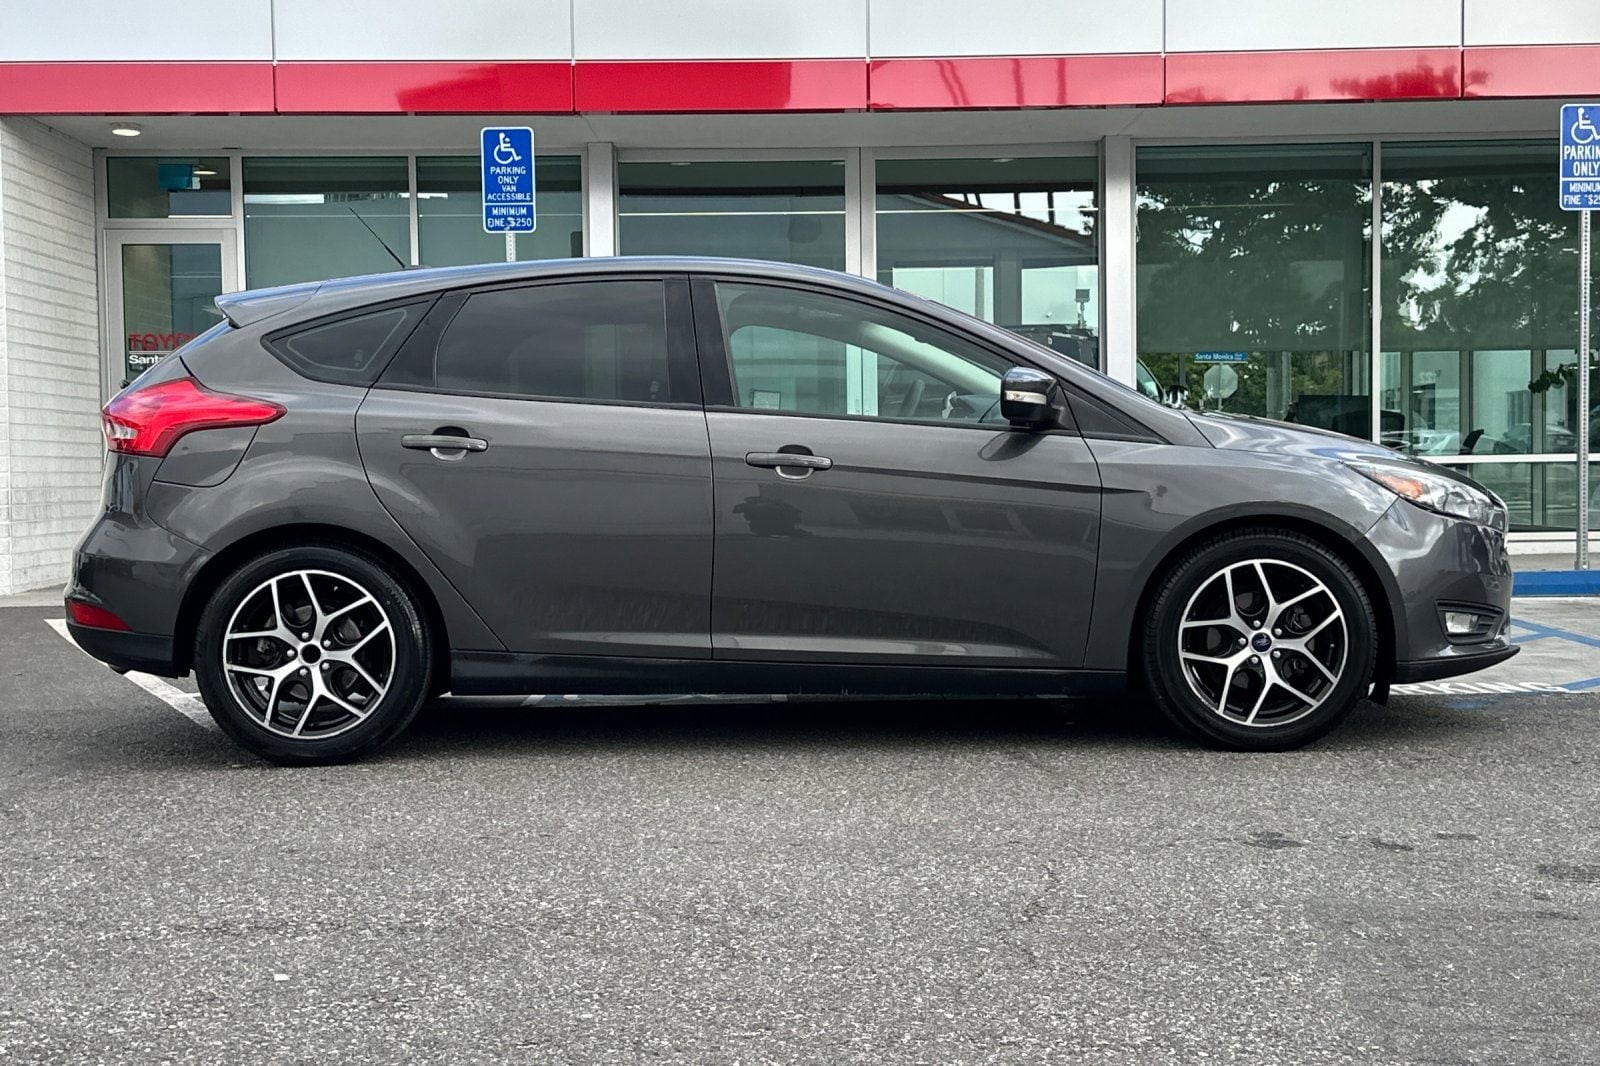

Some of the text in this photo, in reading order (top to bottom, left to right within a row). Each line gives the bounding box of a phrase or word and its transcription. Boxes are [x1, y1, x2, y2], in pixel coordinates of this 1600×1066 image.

[1564, 145, 1600, 160] PARKIN
[490, 166, 526, 175] PARKING
[1573, 161, 1600, 177] ONLY
[497, 175, 519, 184] ONLY
[487, 193, 531, 201] ACCESSIBLE
[1564, 194, 1581, 205] FINE
[492, 207, 527, 216] MINIMUM
[129, 355, 162, 364] Sant
[1195, 352, 1211, 360] Santa
[1212, 352, 1234, 360] Monica
